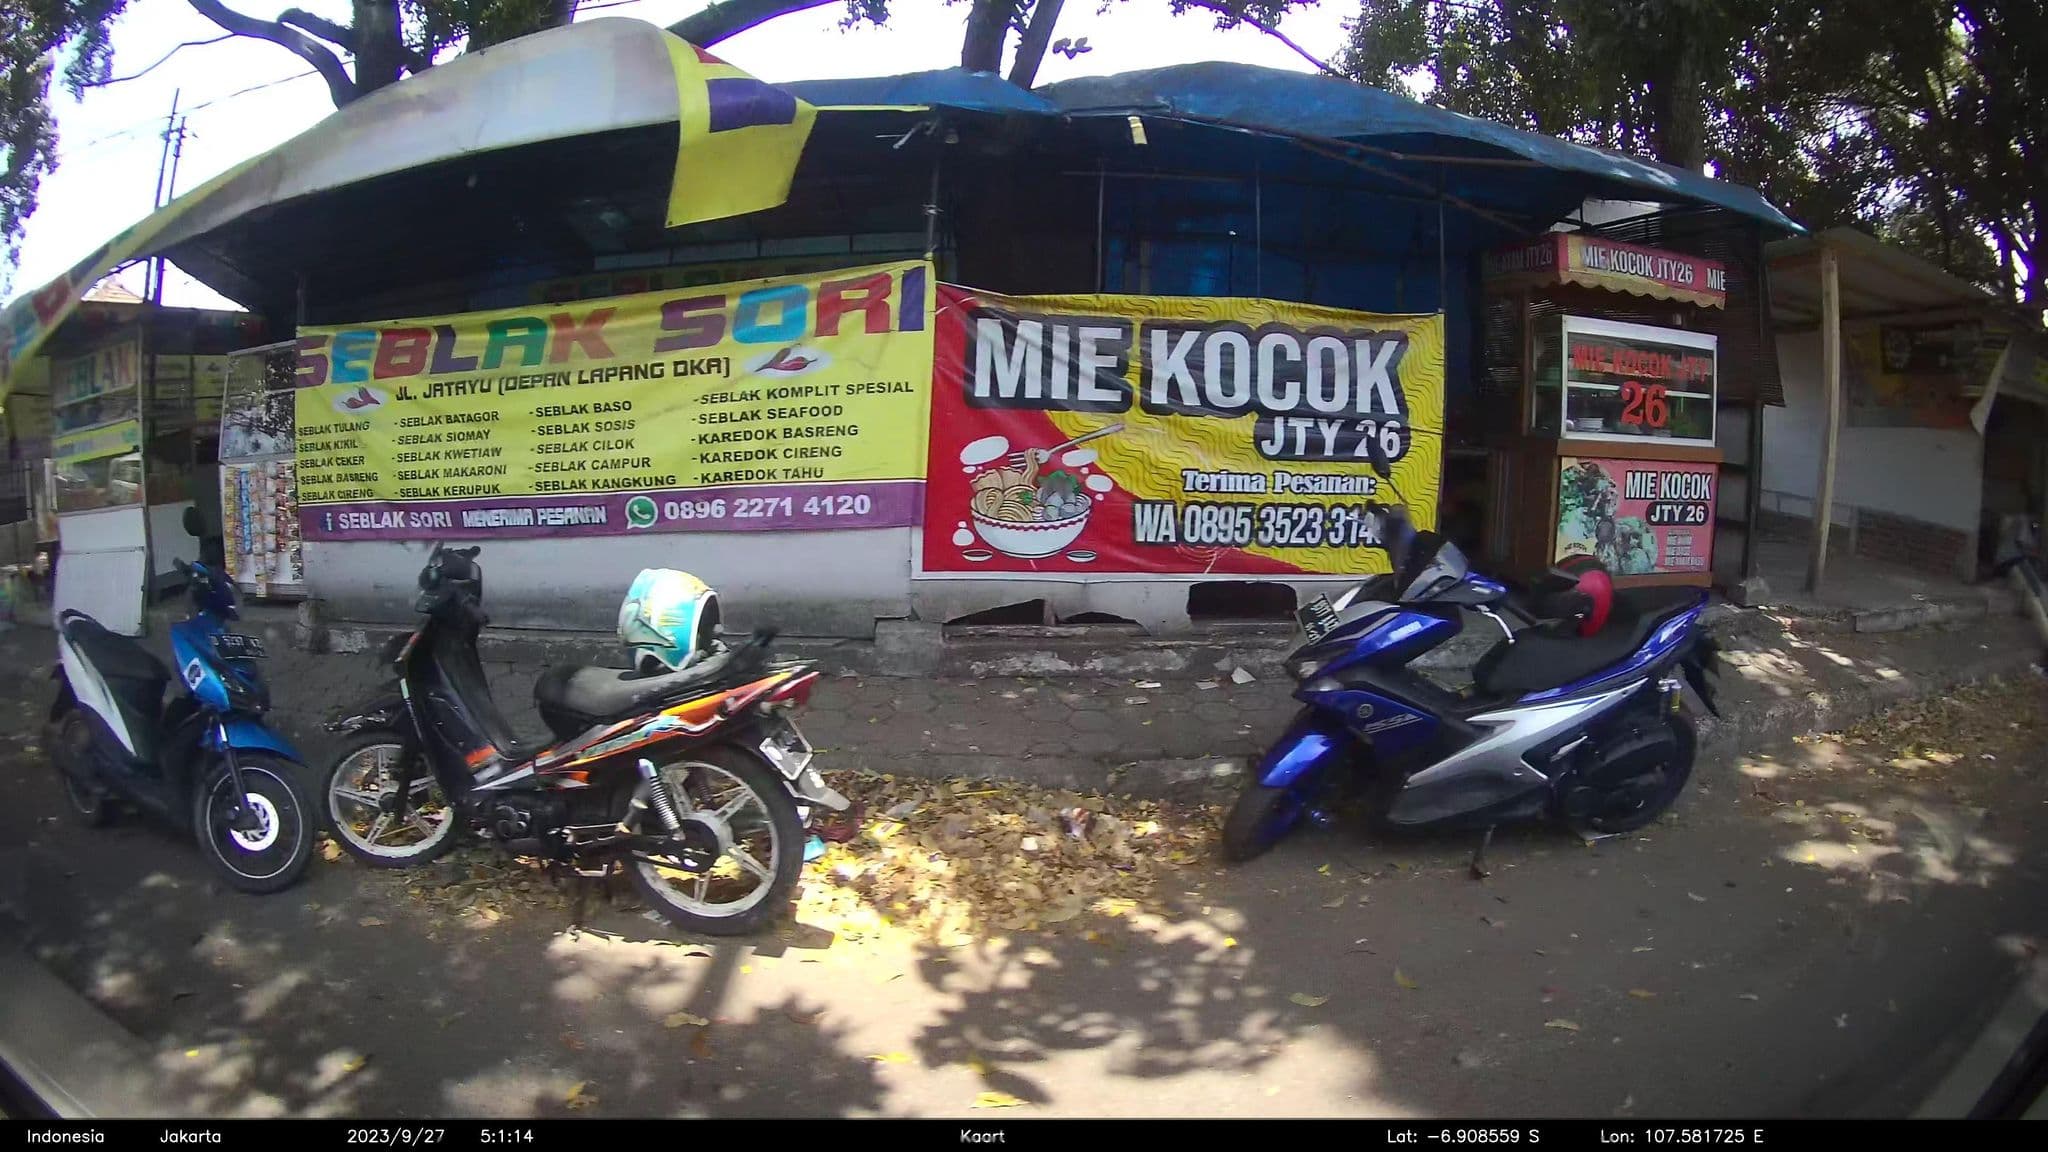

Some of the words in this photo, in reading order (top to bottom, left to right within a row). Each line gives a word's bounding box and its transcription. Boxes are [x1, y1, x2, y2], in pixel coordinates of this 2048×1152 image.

[1583, 245, 1607, 271] MIE
[1609, 249, 1654, 277] KOCOK
[1656, 258, 1693, 285] JTY26
[1706, 267, 1727, 292] MIE
[295, 306, 617, 389] SEBLAK
[653, 265, 926, 353] SORI
[972, 317, 1124, 404] MIE
[1149, 329, 1401, 415] KOCOK
[395, 386, 417, 401] JL.
[423, 378, 492, 398] JATAYU
[577, 362, 665, 385] LAPANG
[766, 384, 840, 400] KOMPLIT
[845, 381, 915, 396] SPESIAL
[593, 400, 632, 413] BASO
[766, 405, 844, 420] SEAFOOD
[1620, 380, 1669, 429] 26
[445, 410, 500, 424] BATAGOR
[298, 424, 332, 437] SEBLAK
[333, 421, 371, 433] TULANG
[594, 419, 636, 433] SOSIS
[782, 424, 859, 440] BASRENG
[446, 429, 491, 442] SIOMAY
[1260, 415, 1346, 457] JTY
[592, 438, 635, 451] CILOK
[782, 445, 843, 460] CIRENG
[335, 455, 366, 467] CEKER
[444, 446, 503, 460] KWETIAW
[443, 464, 508, 478] MAKARONI
[591, 456, 652, 471] CAMPUR
[782, 467, 825, 480] TAHU
[443, 483, 502, 497] KERUPUK
[591, 474, 677, 490] KANGKUNG
[1181, 469, 1267, 494] Terima
[1272, 470, 1378, 495] Pesanan:
[1625, 470, 1659, 501] MIE
[1660, 471, 1713, 501] KOCOK
[663, 498, 727, 520] 0896
[733, 496, 794, 518] 2271
[803, 494, 872, 516] 4120
[1650, 504, 1683, 523] JTY
[1685, 504, 1706, 524] 26
[338, 510, 406, 530] SEBLAK
[409, 510, 453, 529] SORI
[1133, 503, 1178, 543] WA
[1183, 504, 1252, 544] 0895
[1258, 505, 1325, 546] 3523
